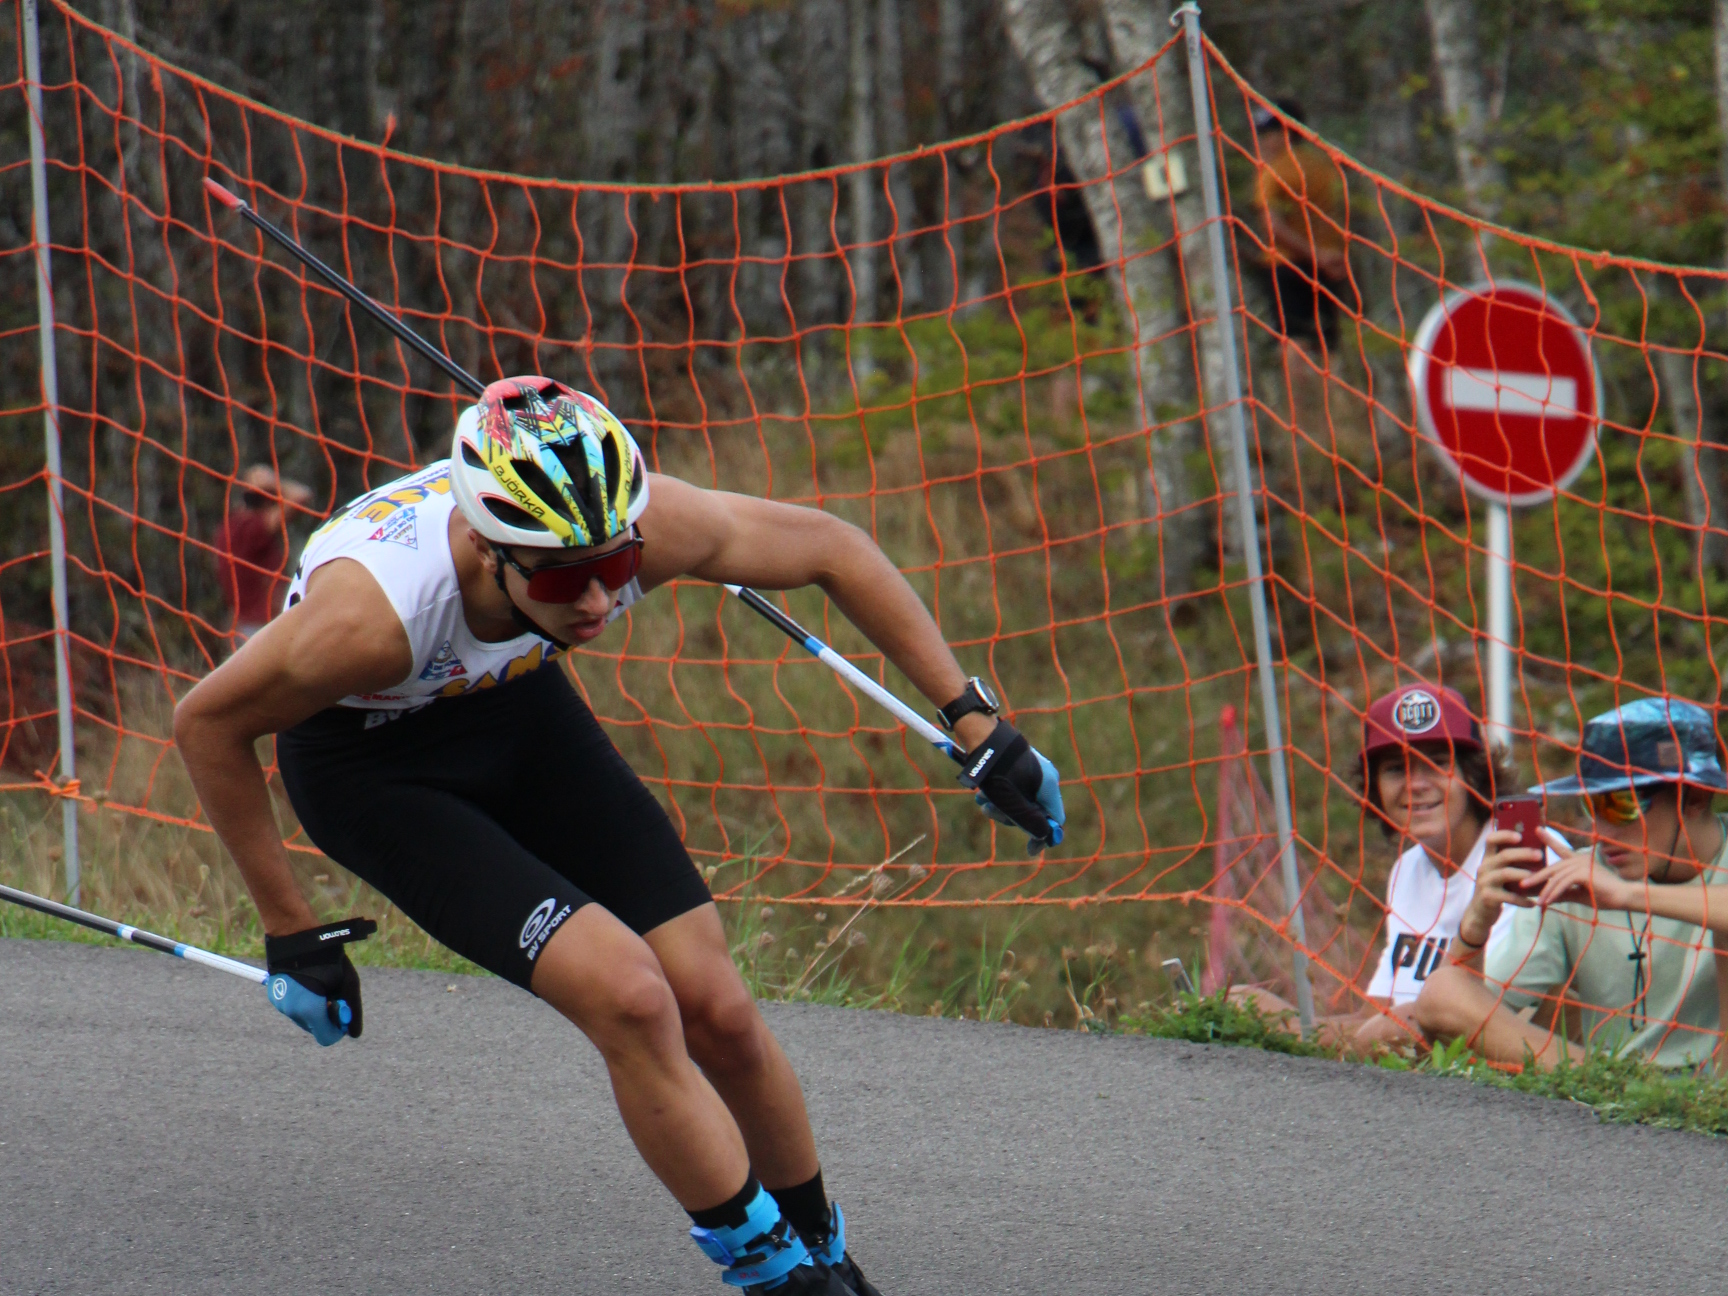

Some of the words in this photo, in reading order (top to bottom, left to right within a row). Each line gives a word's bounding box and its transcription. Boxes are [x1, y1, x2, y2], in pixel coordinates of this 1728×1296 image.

[494, 465, 545, 518] BJÖRKA
[527, 940, 540, 960] BV
[538, 904, 572, 943] SPORT
